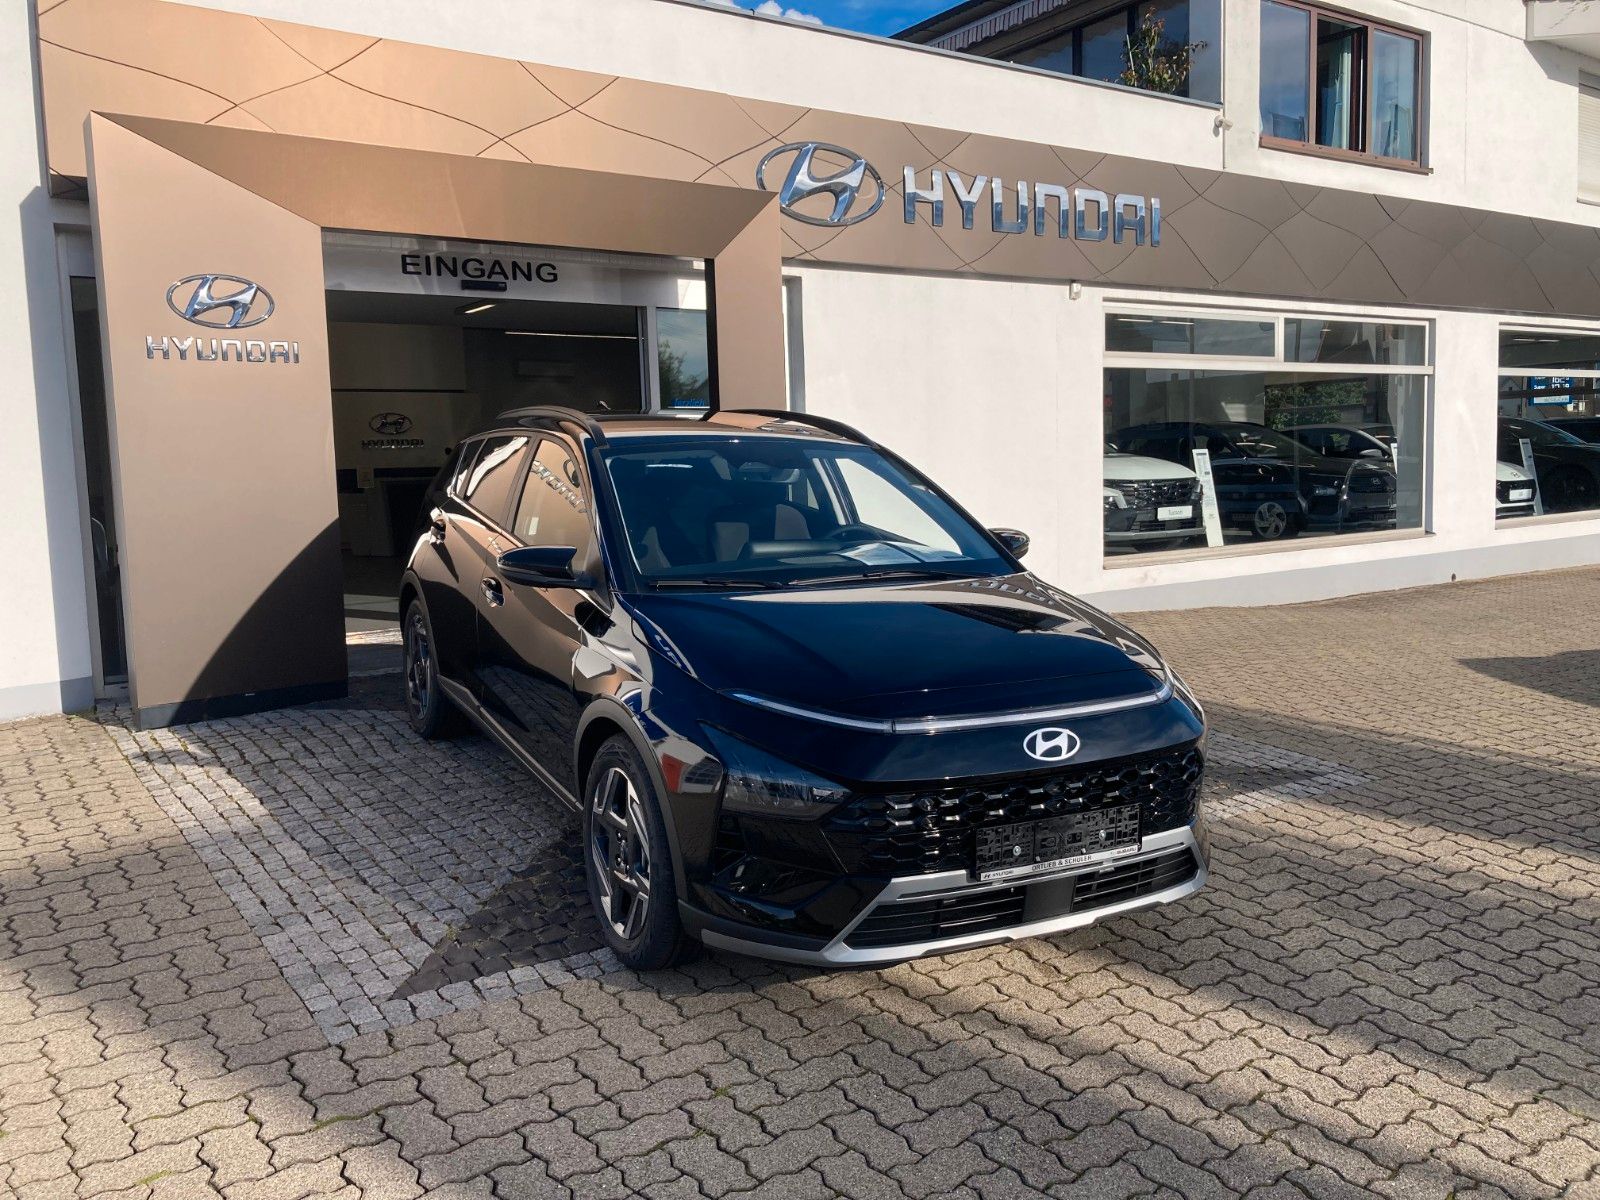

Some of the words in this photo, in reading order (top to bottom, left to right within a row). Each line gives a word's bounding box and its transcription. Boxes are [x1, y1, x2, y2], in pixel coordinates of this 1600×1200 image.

[902, 165, 1162, 247] HYUNDAI
[401, 254, 559, 283] EINGANG
[146, 336, 300, 364] HYUNDAI
